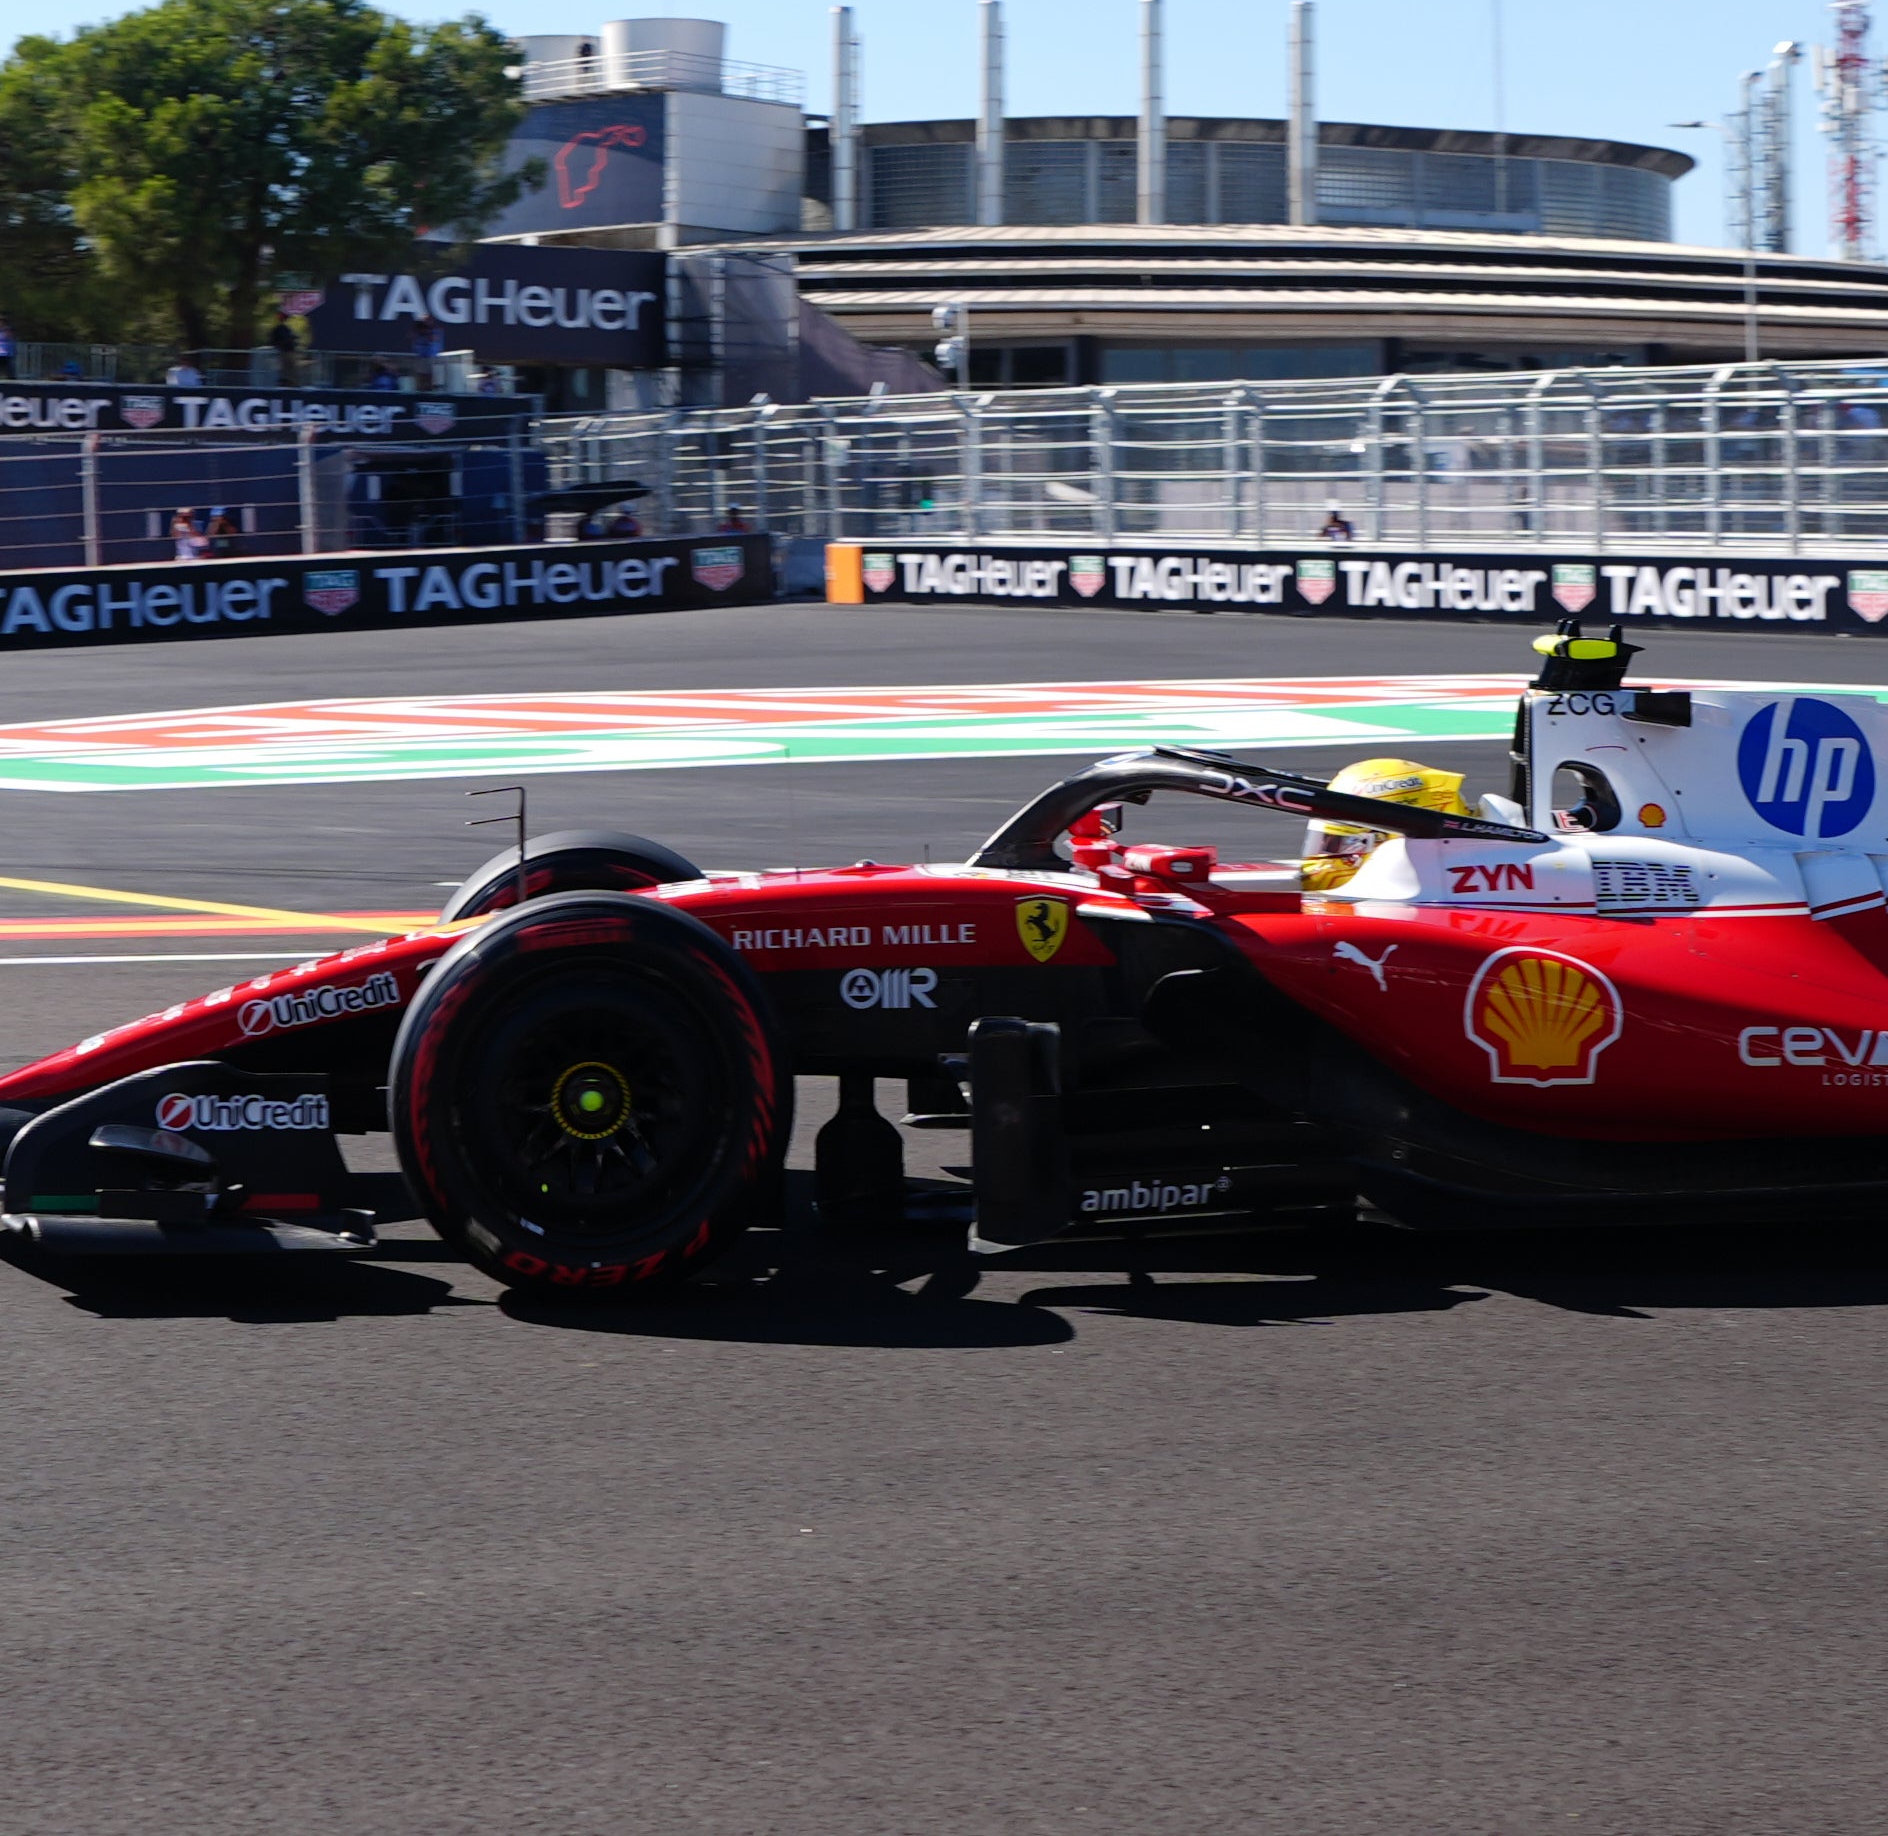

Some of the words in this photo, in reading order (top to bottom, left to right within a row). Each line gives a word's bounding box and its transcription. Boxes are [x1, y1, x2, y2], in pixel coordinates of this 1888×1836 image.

[1756, 696, 1861, 838] hp
[1200, 770, 1316, 812] DXC
[1450, 864, 1535, 894] ZYN
[1592, 861, 1699, 902] IBM
[732, 927, 871, 951] RICHARD
[883, 924, 976, 945] MILLE
[272, 973, 399, 1025] UniCredit
[194, 1094, 329, 1129] UniCredit
